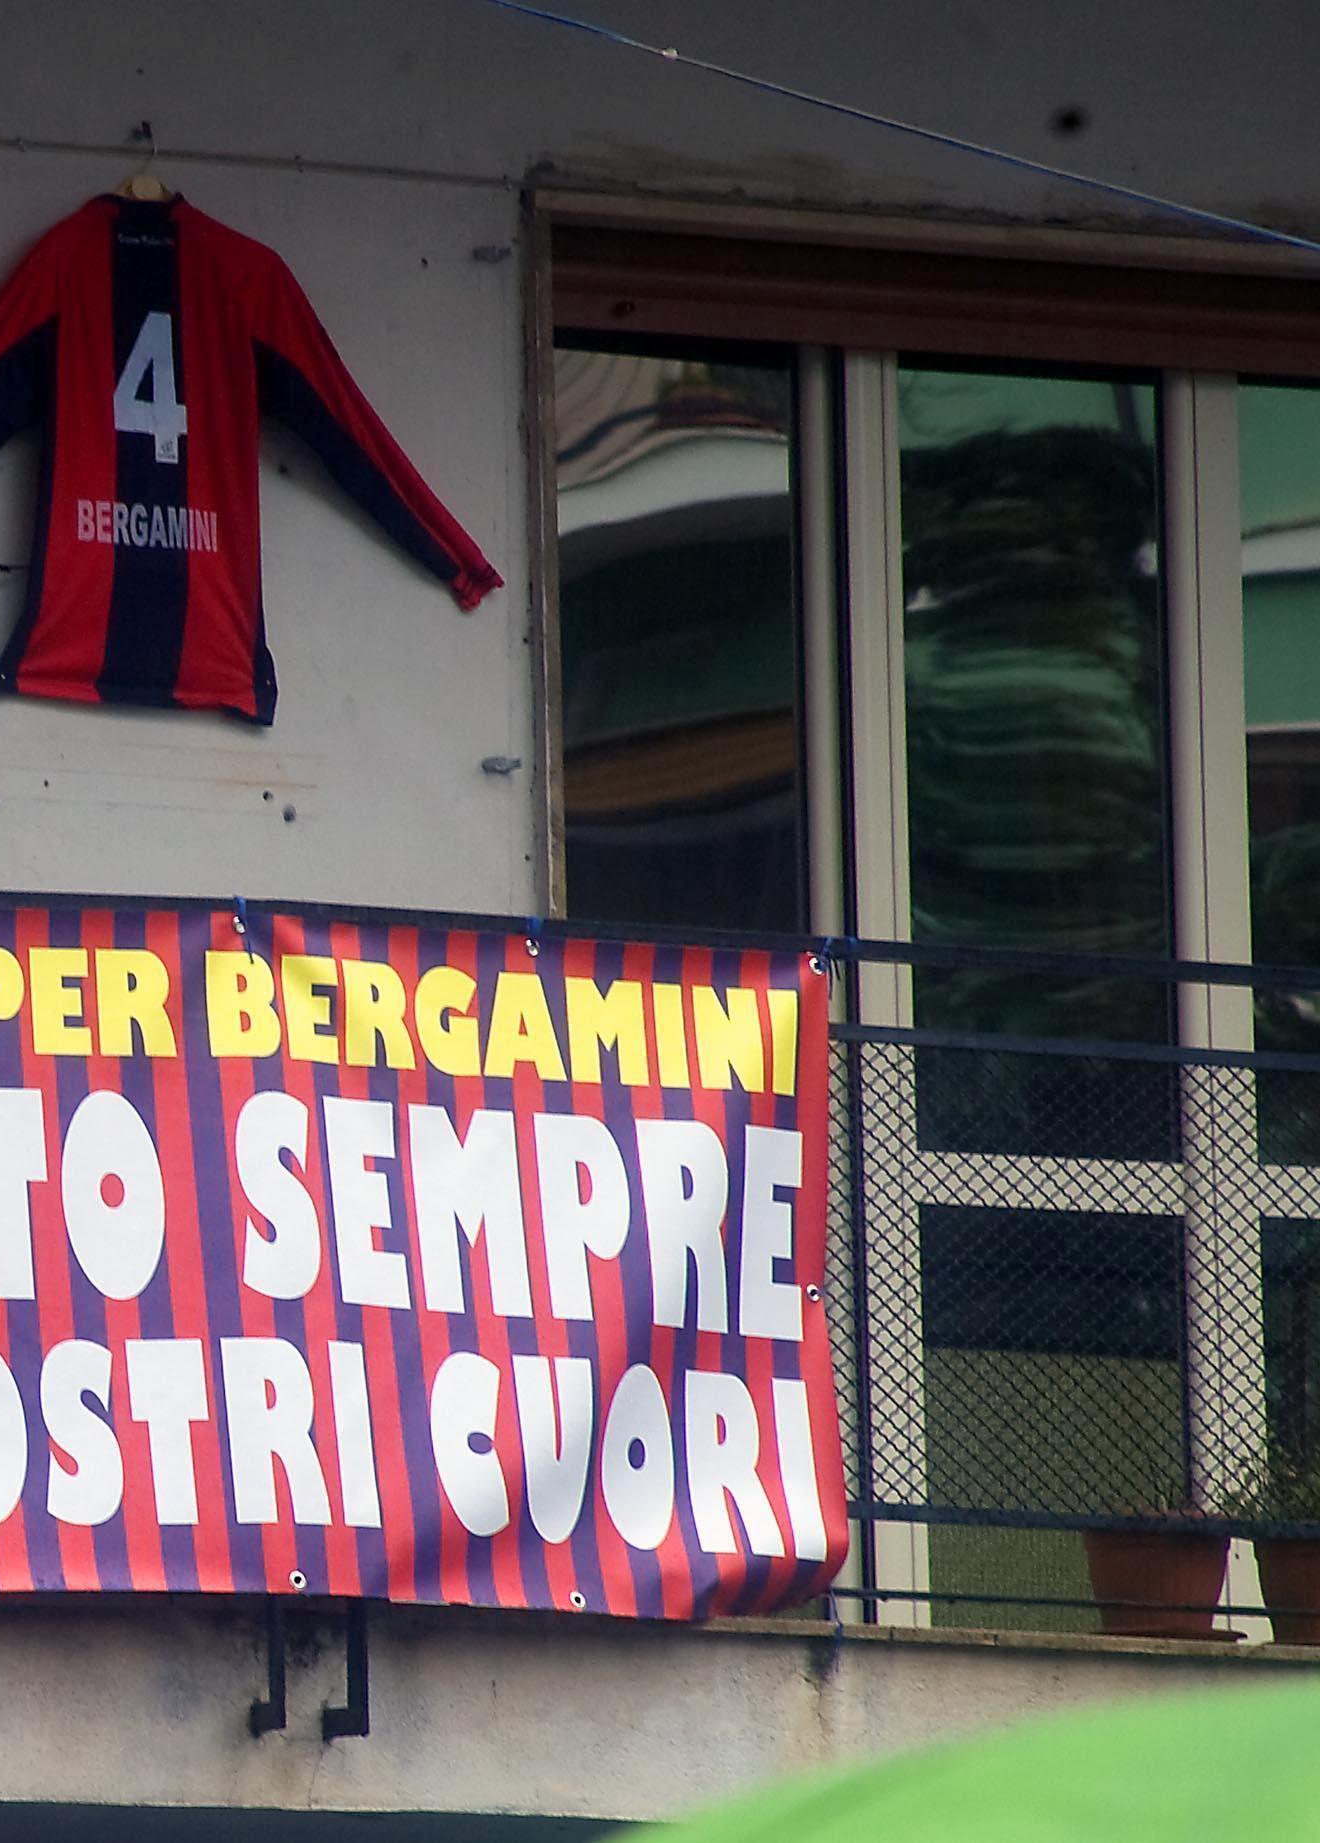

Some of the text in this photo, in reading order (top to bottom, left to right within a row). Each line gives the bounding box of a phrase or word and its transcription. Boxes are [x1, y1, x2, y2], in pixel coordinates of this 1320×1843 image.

[113, 311, 188, 464] 4
[77, 499, 218, 553] BERGAMINI
[205, 950, 799, 1096] BERGAMINI
[235, 1090, 803, 1341] SEMPRE
[430, 1351, 828, 1561] CUORI
